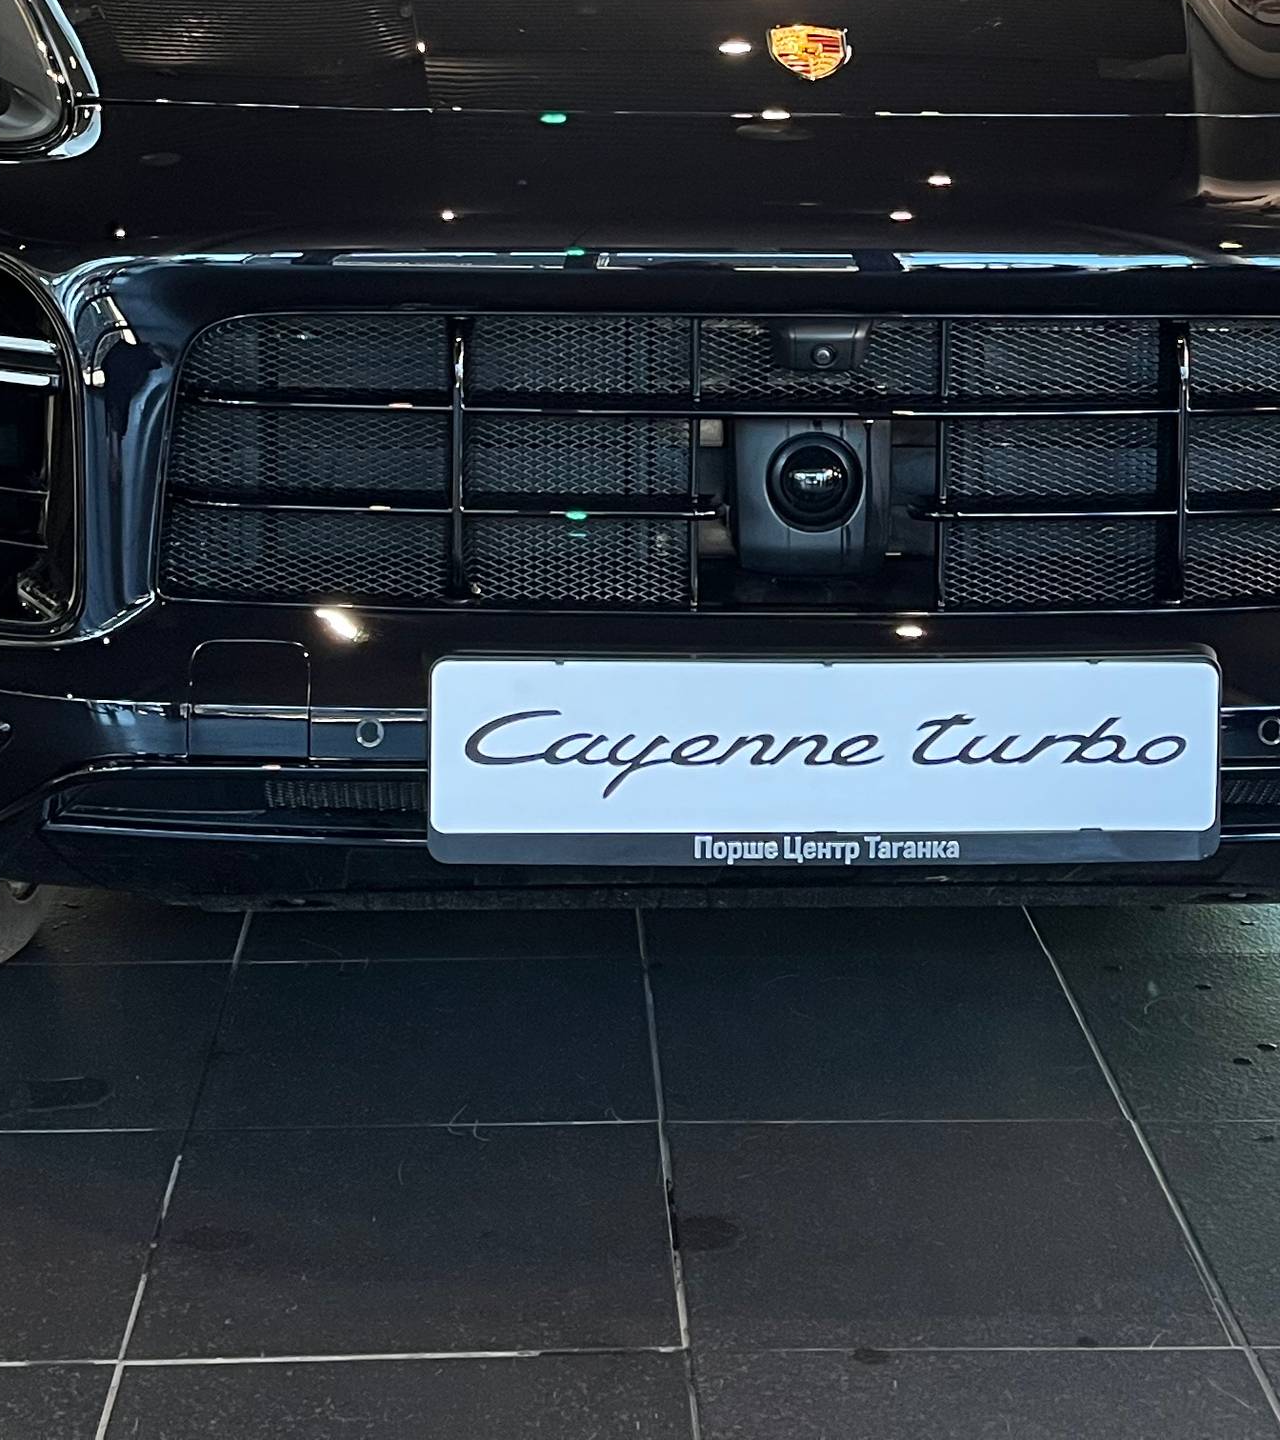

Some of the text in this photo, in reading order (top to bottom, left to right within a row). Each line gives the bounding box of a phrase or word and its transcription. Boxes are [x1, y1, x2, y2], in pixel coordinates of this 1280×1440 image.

[464, 709, 1187, 799] Cayenne turbo
[693, 836, 960, 864] Порше Центр Таганка
